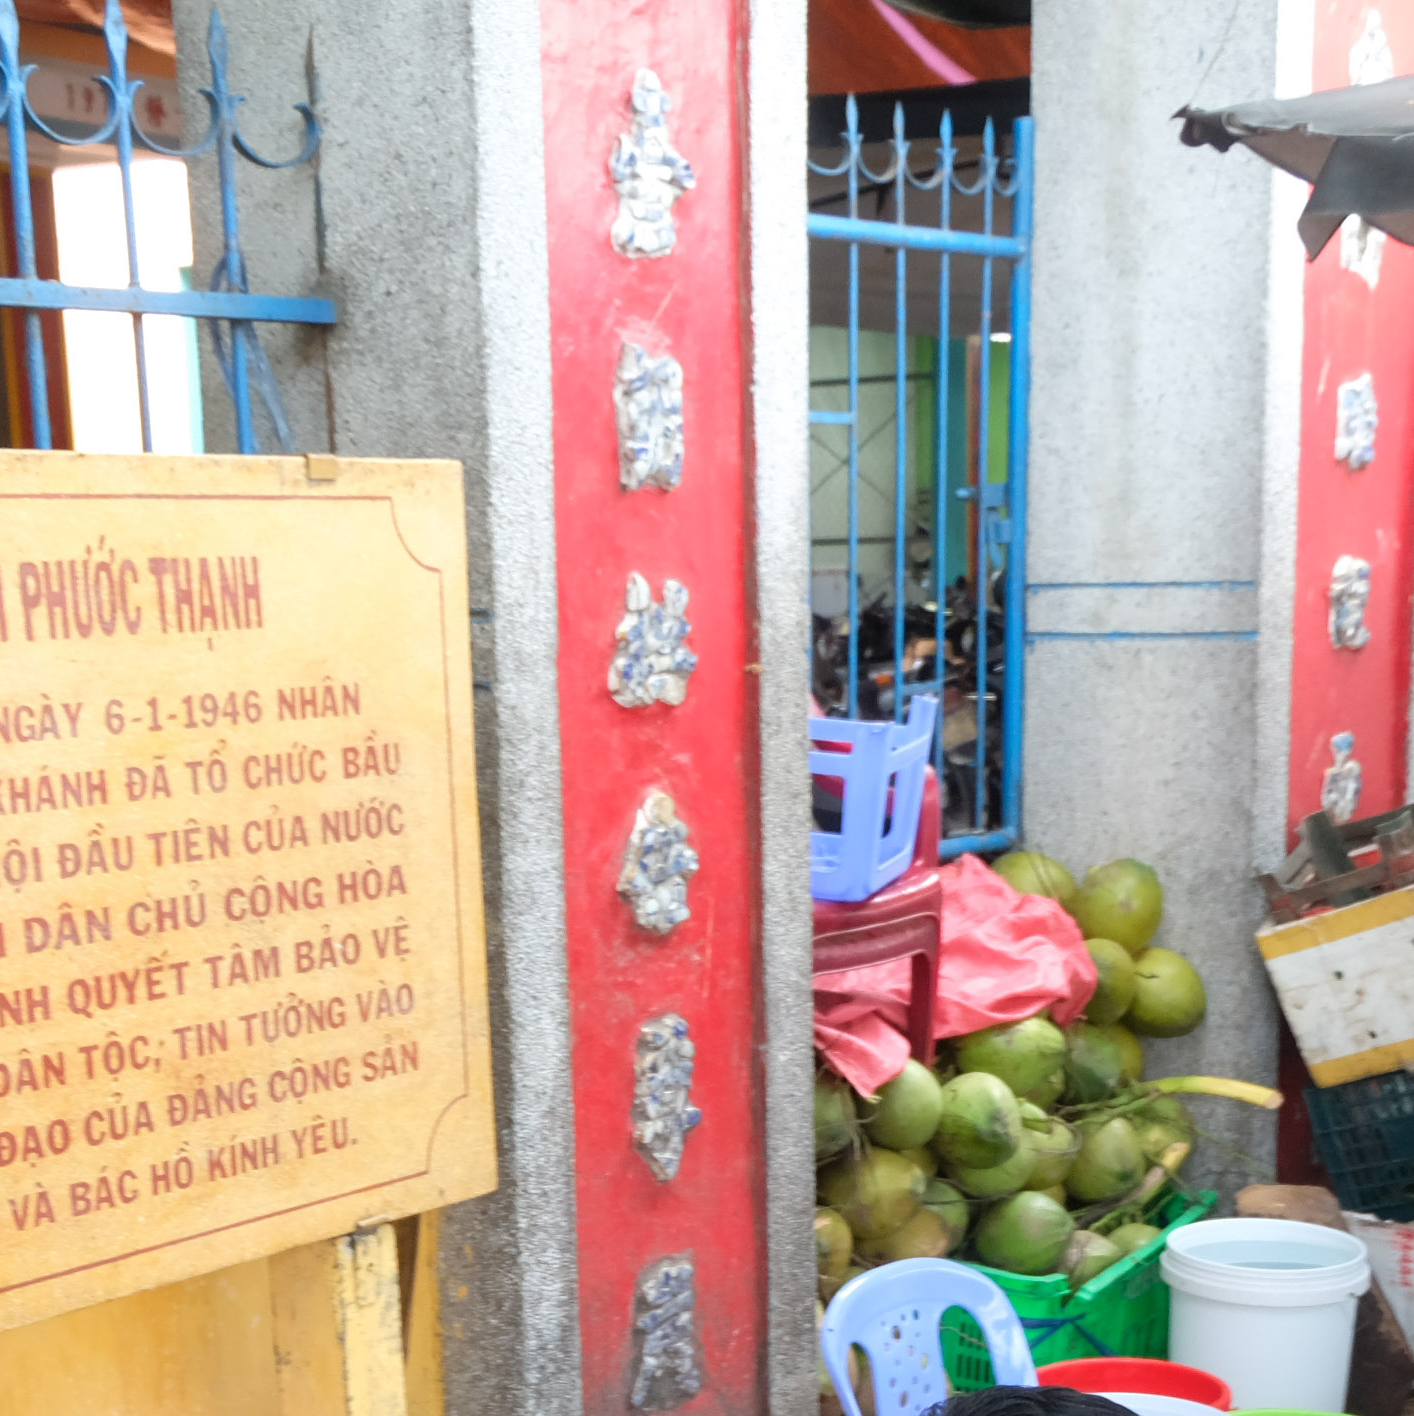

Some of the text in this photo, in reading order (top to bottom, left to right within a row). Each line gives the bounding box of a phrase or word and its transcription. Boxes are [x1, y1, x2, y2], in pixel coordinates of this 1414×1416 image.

[19, 535, 142, 641] PHƯỚC
[148, 556, 263, 650] THẠNH
[105, 690, 262, 735] 6-1-1946
[277, 676, 360, 720] NHÂN
[125, 755, 171, 801] ĐÃ
[185, 739, 228, 795] TỔ
[243, 741, 327, 790] CHỨC
[342, 730, 400, 779] BẦU
[58, 823, 133, 878] ĐẦU
[147, 819, 230, 866] TIÊN
[243, 805, 308, 854] CỦA
[321, 798, 404, 844] NƯỚC
[23, 902, 111, 953] DÂN
[127, 880, 206, 936] CHỦ
[224, 875, 325, 925] CỘNG
[337, 860, 407, 904] HÒA
[67, 950, 189, 1018] QUYẾT
[204, 943, 280, 988] TÂM
[295, 924, 361, 973] BẢO
[372, 916, 410, 958] VỆ
[173, 1021, 228, 1060] TIN
[240, 992, 346, 1045] TƯỞNG
[356, 981, 415, 1022] VÀO
[83, 1092, 154, 1146] CỦA
[167, 1073, 257, 1126] ĐẢNG
[268, 1057, 351, 1102] CỘNG
[362, 1035, 418, 1082] SẢN
[9, 1183, 56, 1231] VÀ
[70, 1165, 139, 1217] BÁC
[151, 1141, 195, 1196] HỒ
[208, 1135, 280, 1182] KÍNH
